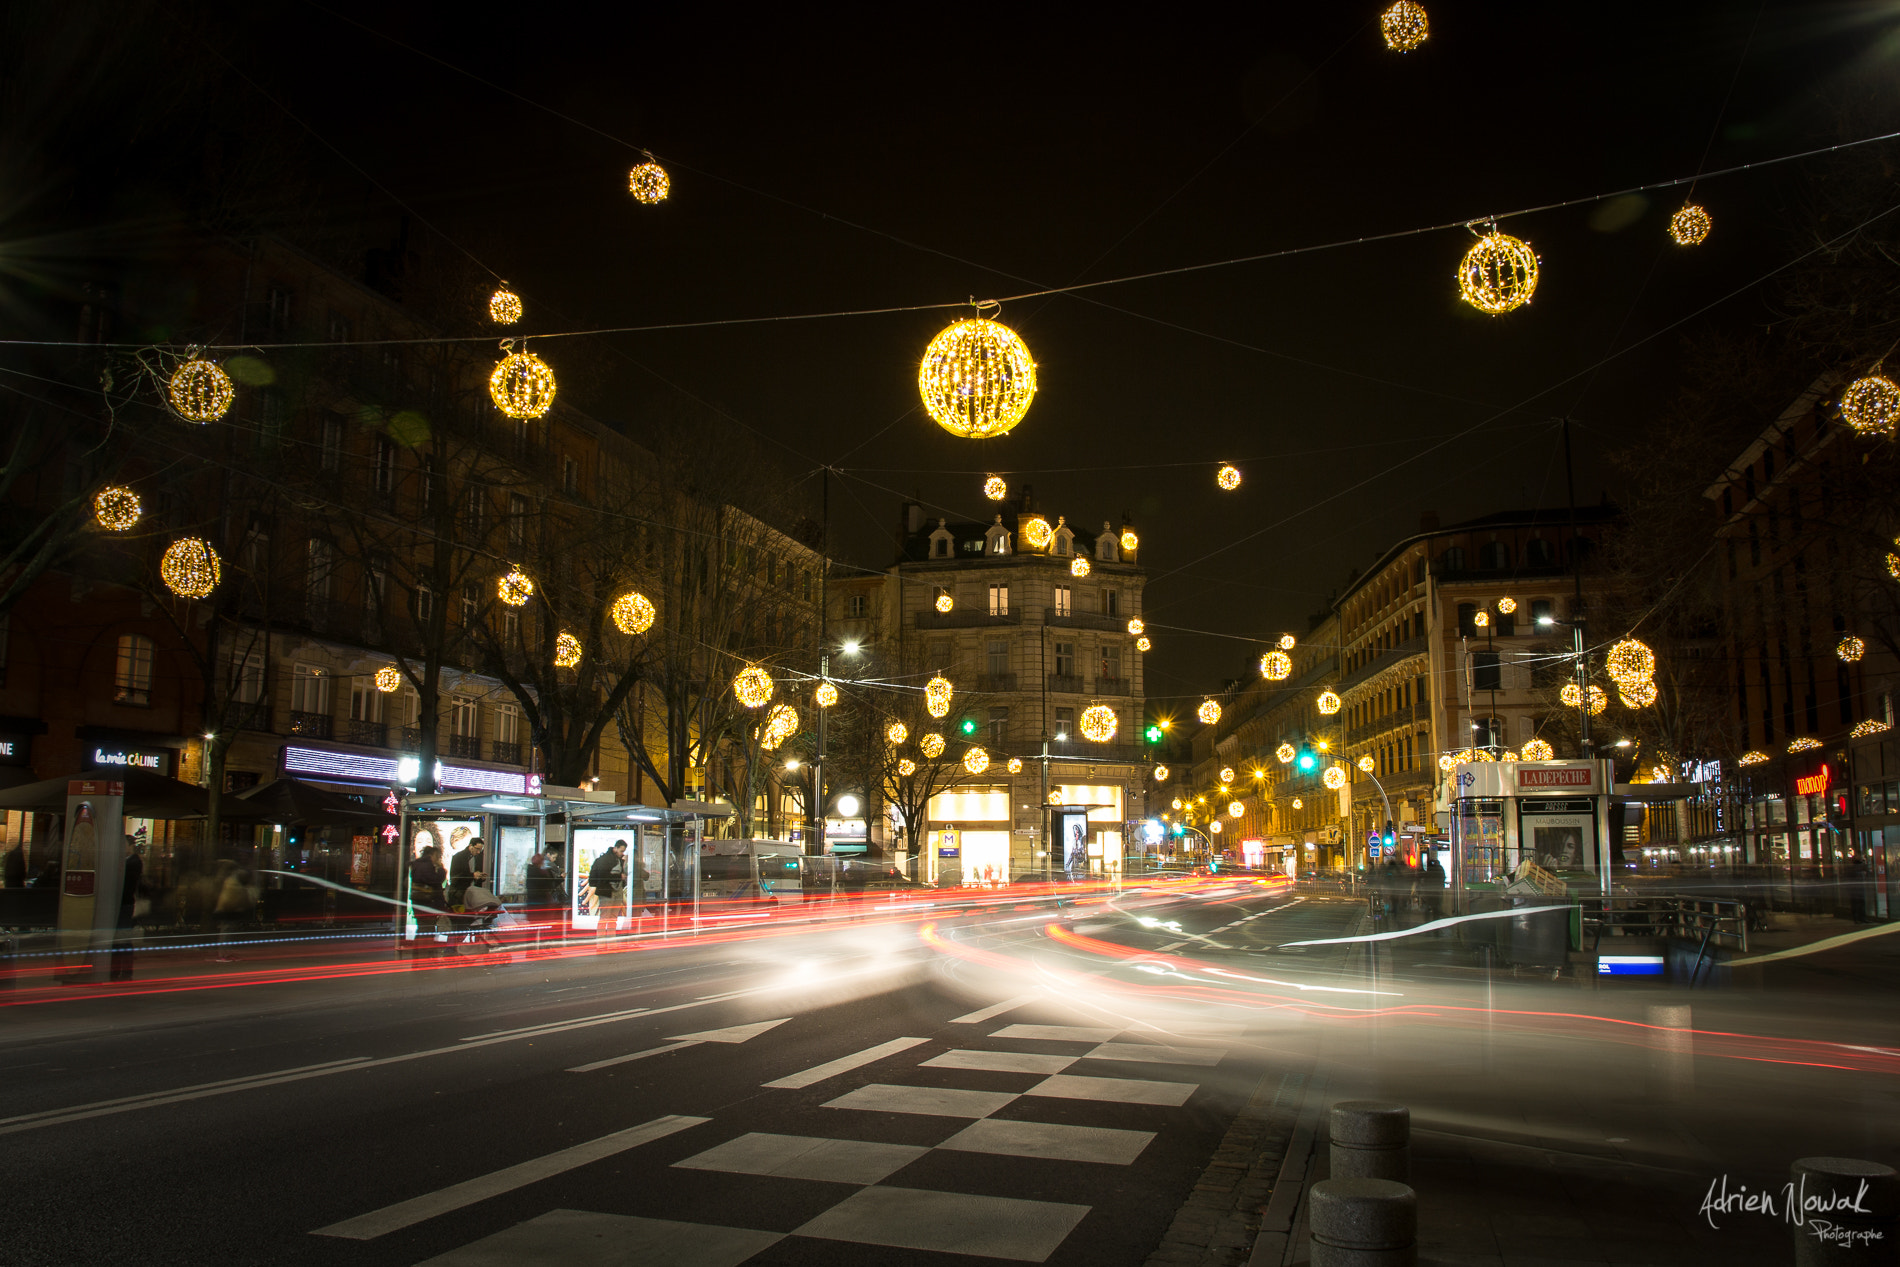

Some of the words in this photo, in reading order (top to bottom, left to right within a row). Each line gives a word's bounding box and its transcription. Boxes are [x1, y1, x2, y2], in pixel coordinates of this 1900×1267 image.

[95, 748, 106, 764] la
[127, 752, 160, 768] CÂLINE
[1524, 771, 1538, 784] LA
[1538, 769, 1587, 784] DÉPÊCHE
[1797, 764, 1828, 798] monop'
[1714, 775, 1724, 829] HOTEL
[1535, 817, 1580, 826] MAUBOUSSIN
[944, 834, 954, 844] M
